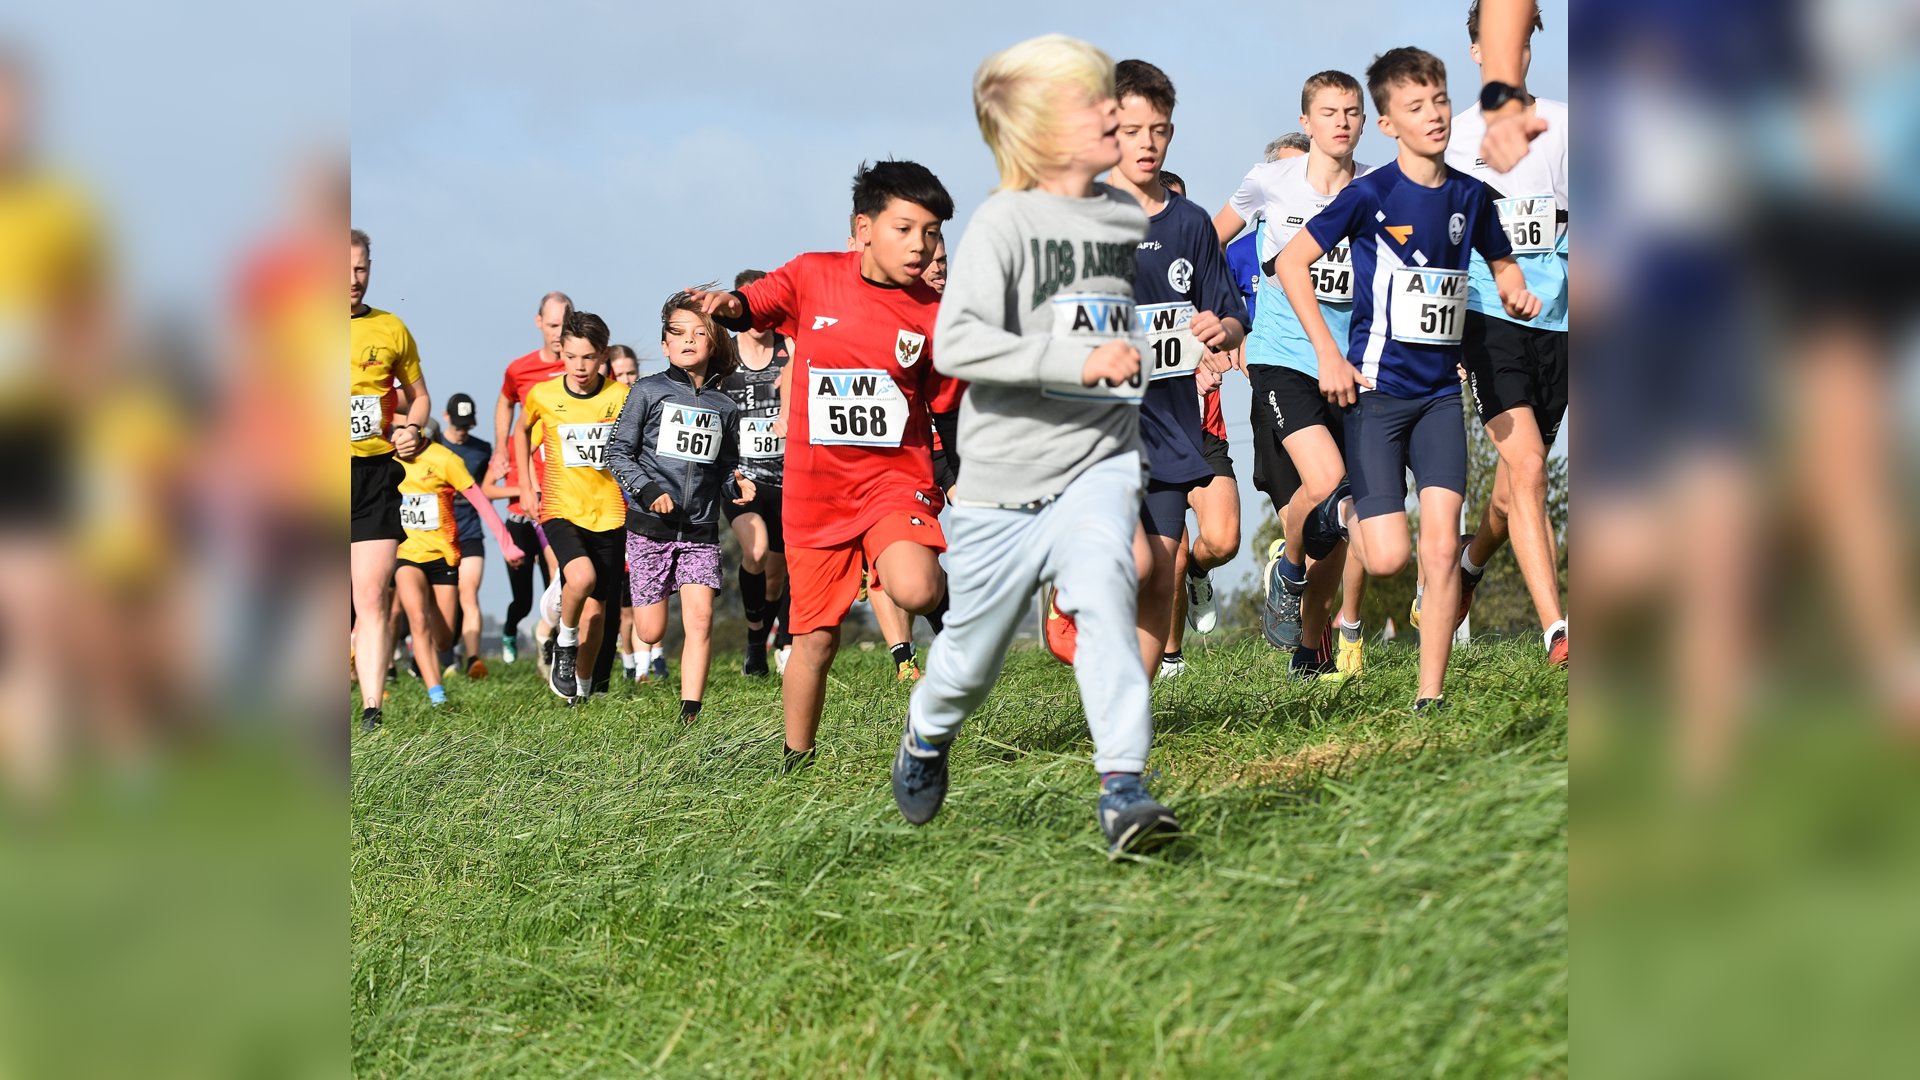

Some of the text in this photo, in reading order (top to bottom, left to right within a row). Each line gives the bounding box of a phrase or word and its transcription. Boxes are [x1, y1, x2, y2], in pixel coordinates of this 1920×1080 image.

[1498, 200, 1535, 218] VW
[1031, 239, 1076, 311] LOS
[1406, 273, 1459, 297] AVW
[1072, 304, 1129, 333] AVW
[1138, 308, 1177, 332] VW
[1420, 303, 1456, 335] 511
[1151, 337, 1181, 369] 10
[817, 376, 877, 397] AVW
[351, 415, 371, 434] 53
[670, 409, 712, 429] AVW
[829, 405, 887, 436] 568
[566, 427, 603, 440] AVW
[676, 430, 713, 456] 567
[754, 436, 779, 453] 581
[576, 444, 606, 463] 547
[402, 509, 426, 525] 504
